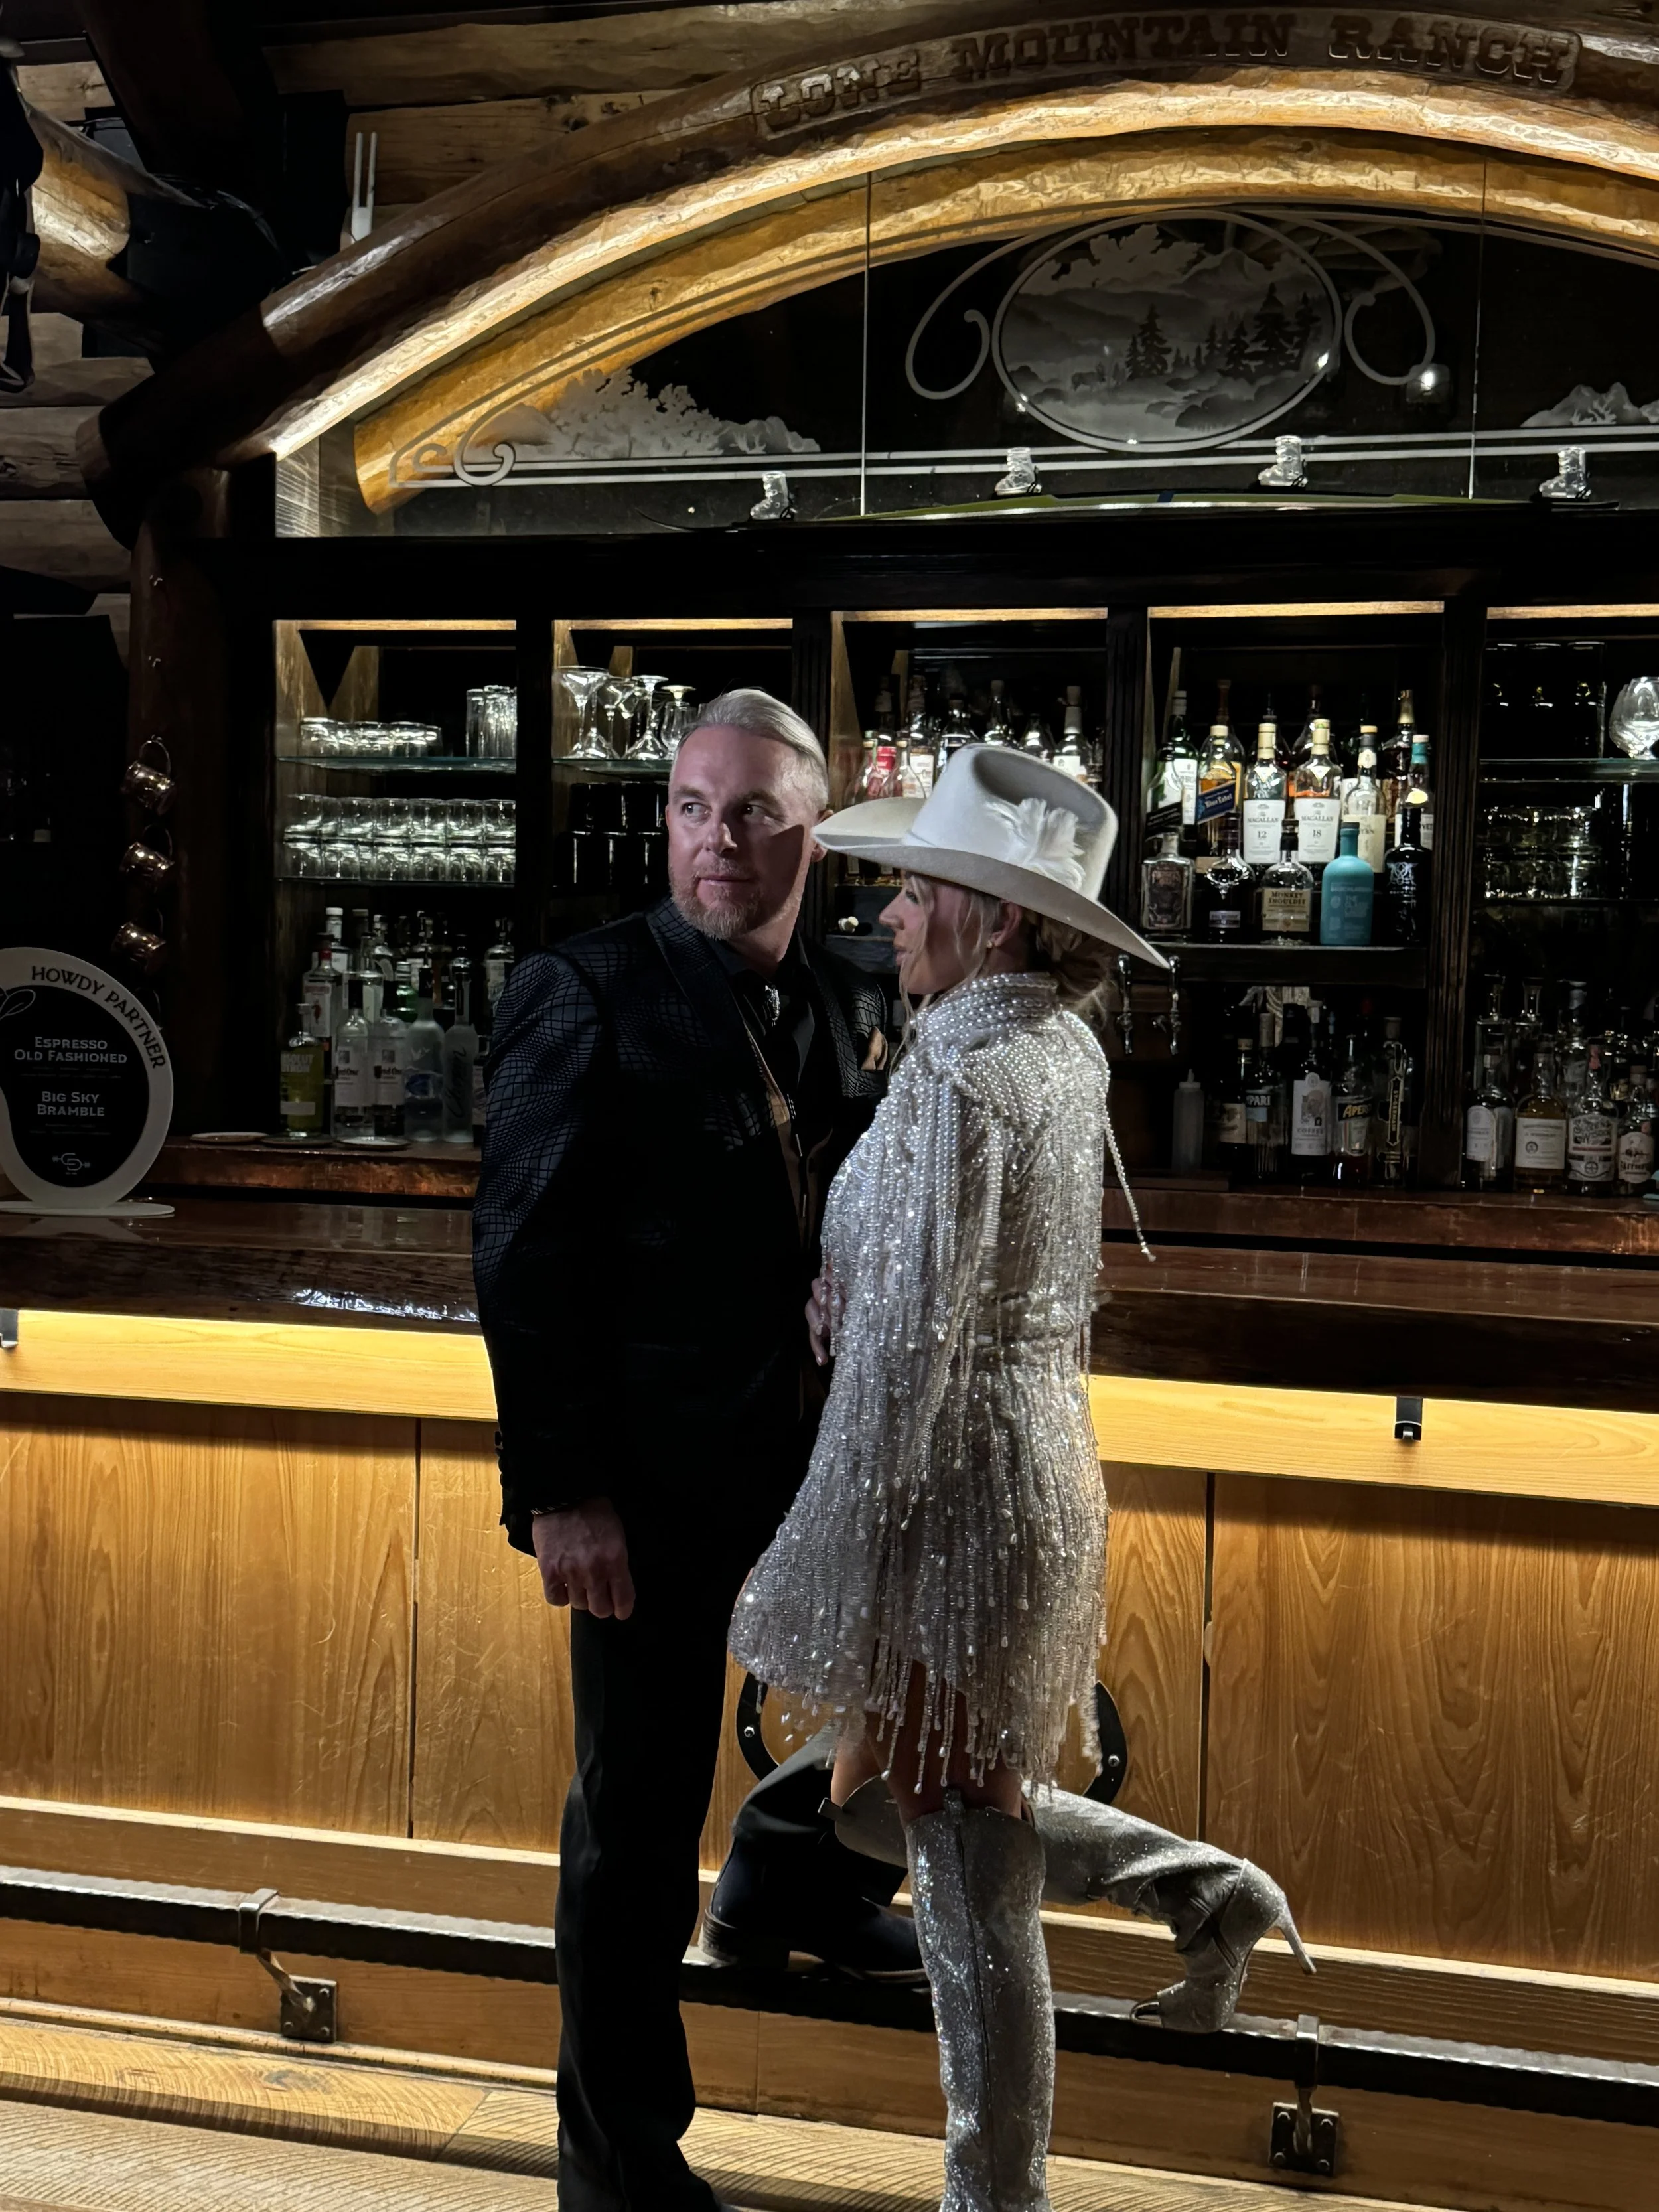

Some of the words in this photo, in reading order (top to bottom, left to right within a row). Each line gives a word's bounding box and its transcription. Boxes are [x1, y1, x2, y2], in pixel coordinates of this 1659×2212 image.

[761, 58, 921, 132] LONE
[950, 13, 1296, 82] MOUNTAIN
[1328, 15, 1570, 84] RANCH
[31, 966, 105, 995] HOWDY
[105, 991, 165, 1069] PARTNER
